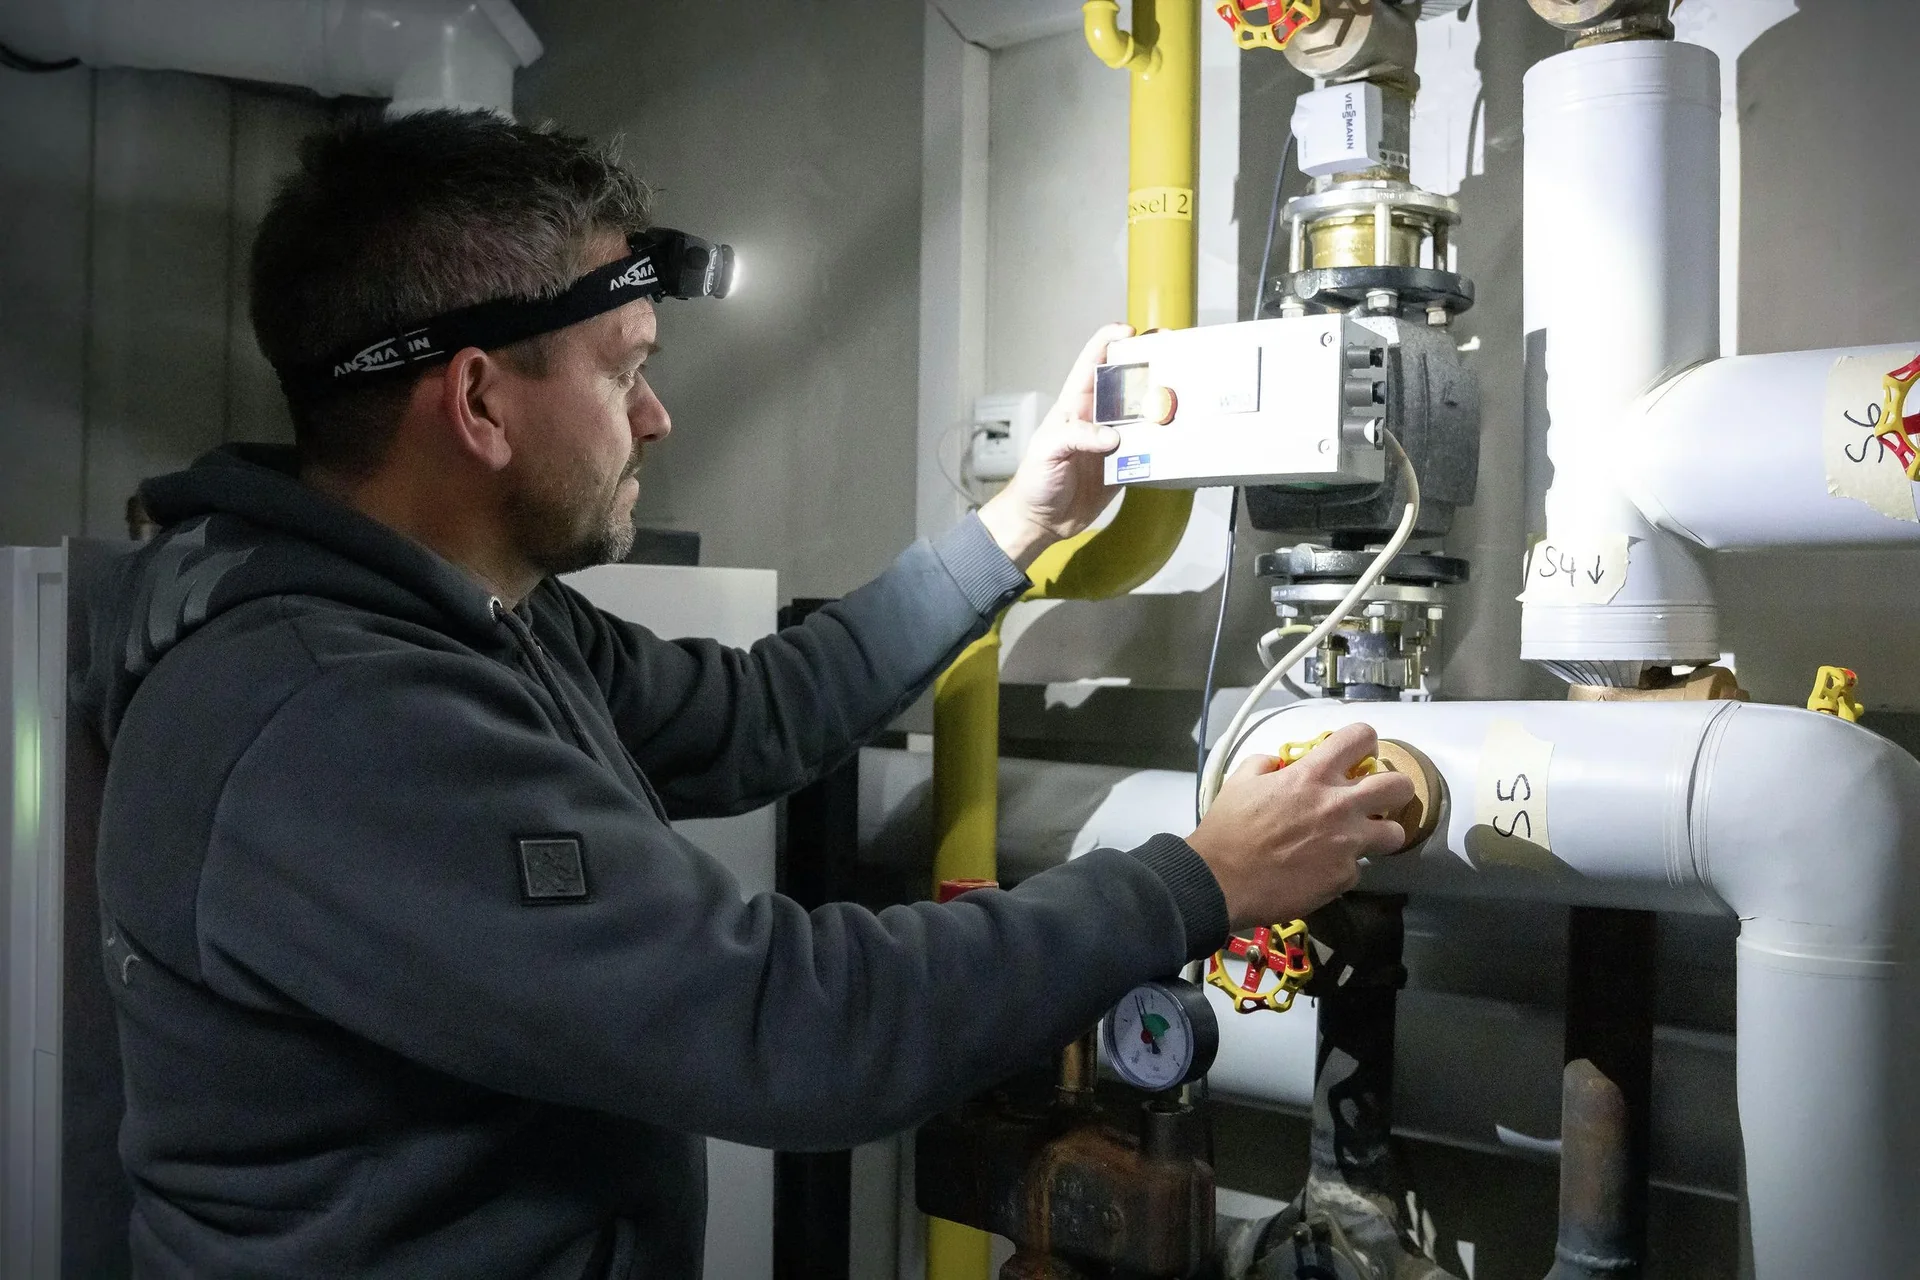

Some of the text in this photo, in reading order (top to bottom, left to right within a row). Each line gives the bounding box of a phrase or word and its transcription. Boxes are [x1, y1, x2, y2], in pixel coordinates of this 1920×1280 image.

[1342, 92, 1356, 150] VIESSMANN
[1177, 193, 1188, 214] 2
[1843, 402, 1885, 464] S6
[1539, 545, 1577, 588] S4
[1492, 773, 1531, 839] S5
